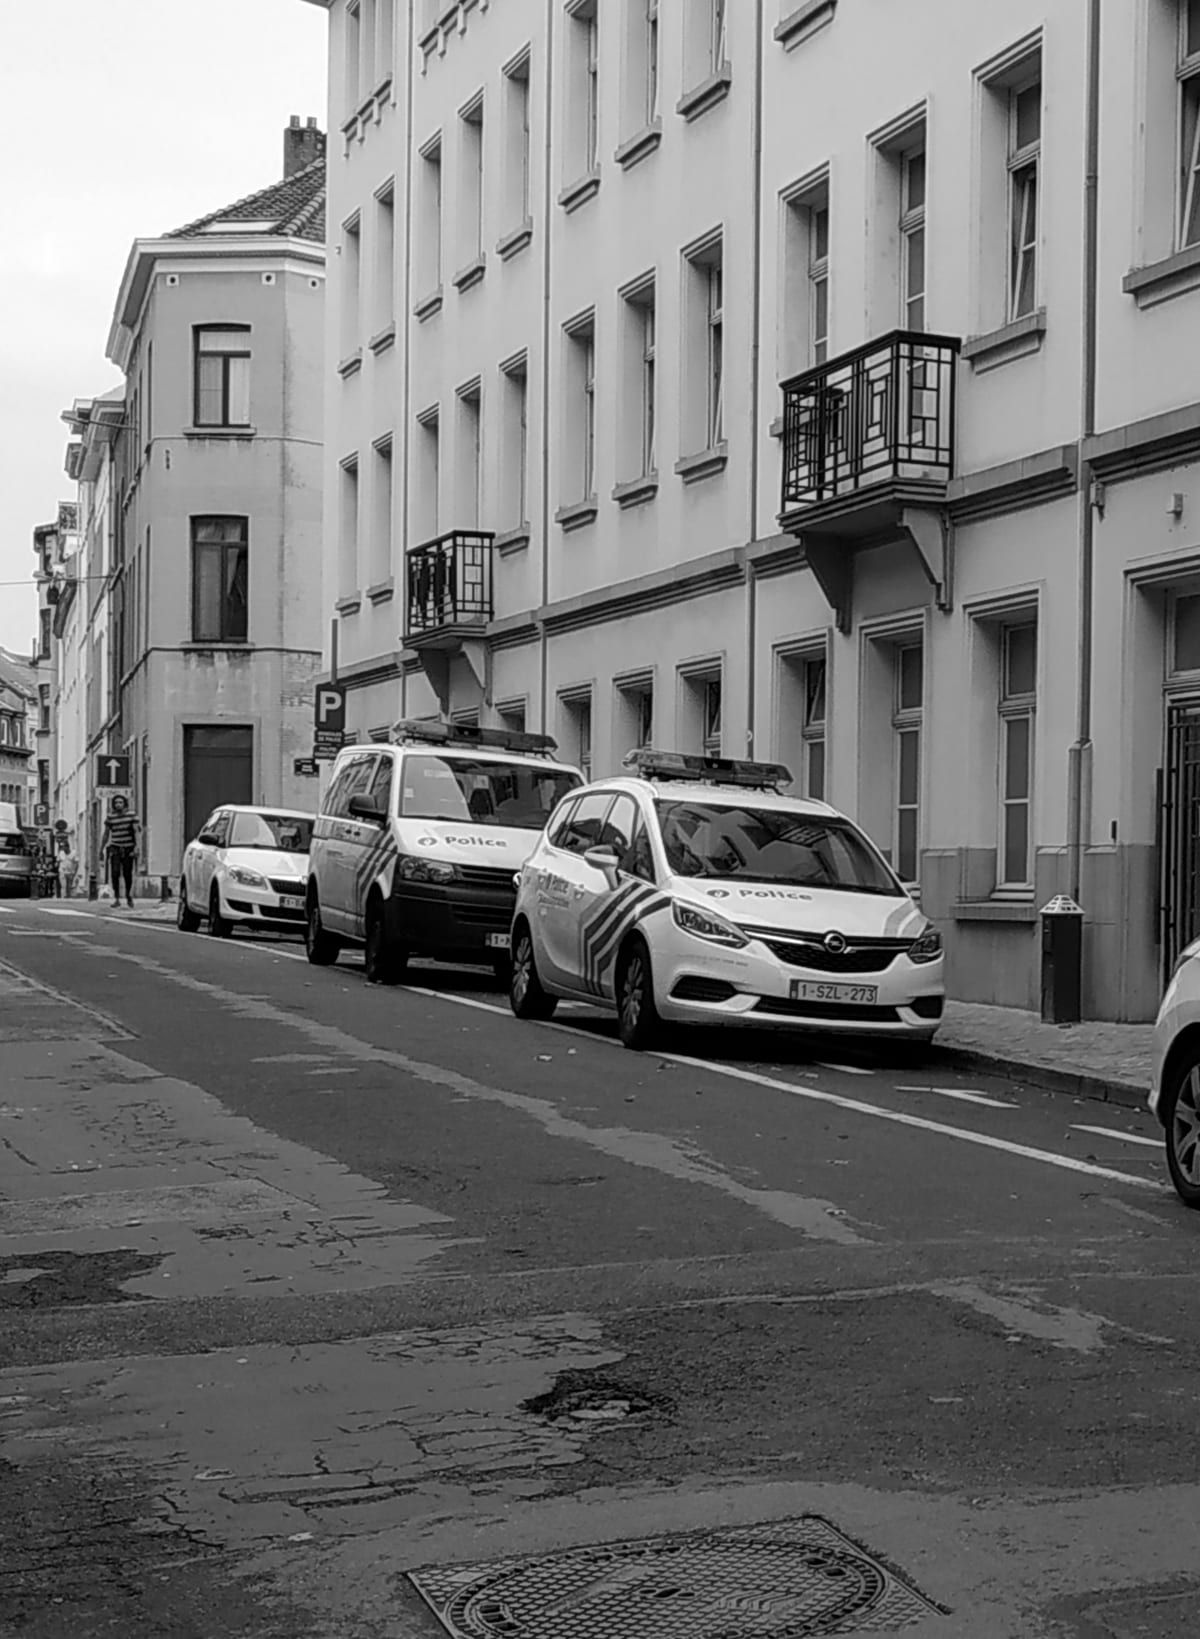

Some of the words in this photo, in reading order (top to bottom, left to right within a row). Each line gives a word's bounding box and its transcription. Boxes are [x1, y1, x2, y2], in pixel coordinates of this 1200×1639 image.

[319, 690, 342, 722] P
[37, 806, 46, 819] P
[444, 834, 507, 848] Police
[740, 889, 813, 901] Police
[800, 984, 874, 1002] 1-SZL-273
